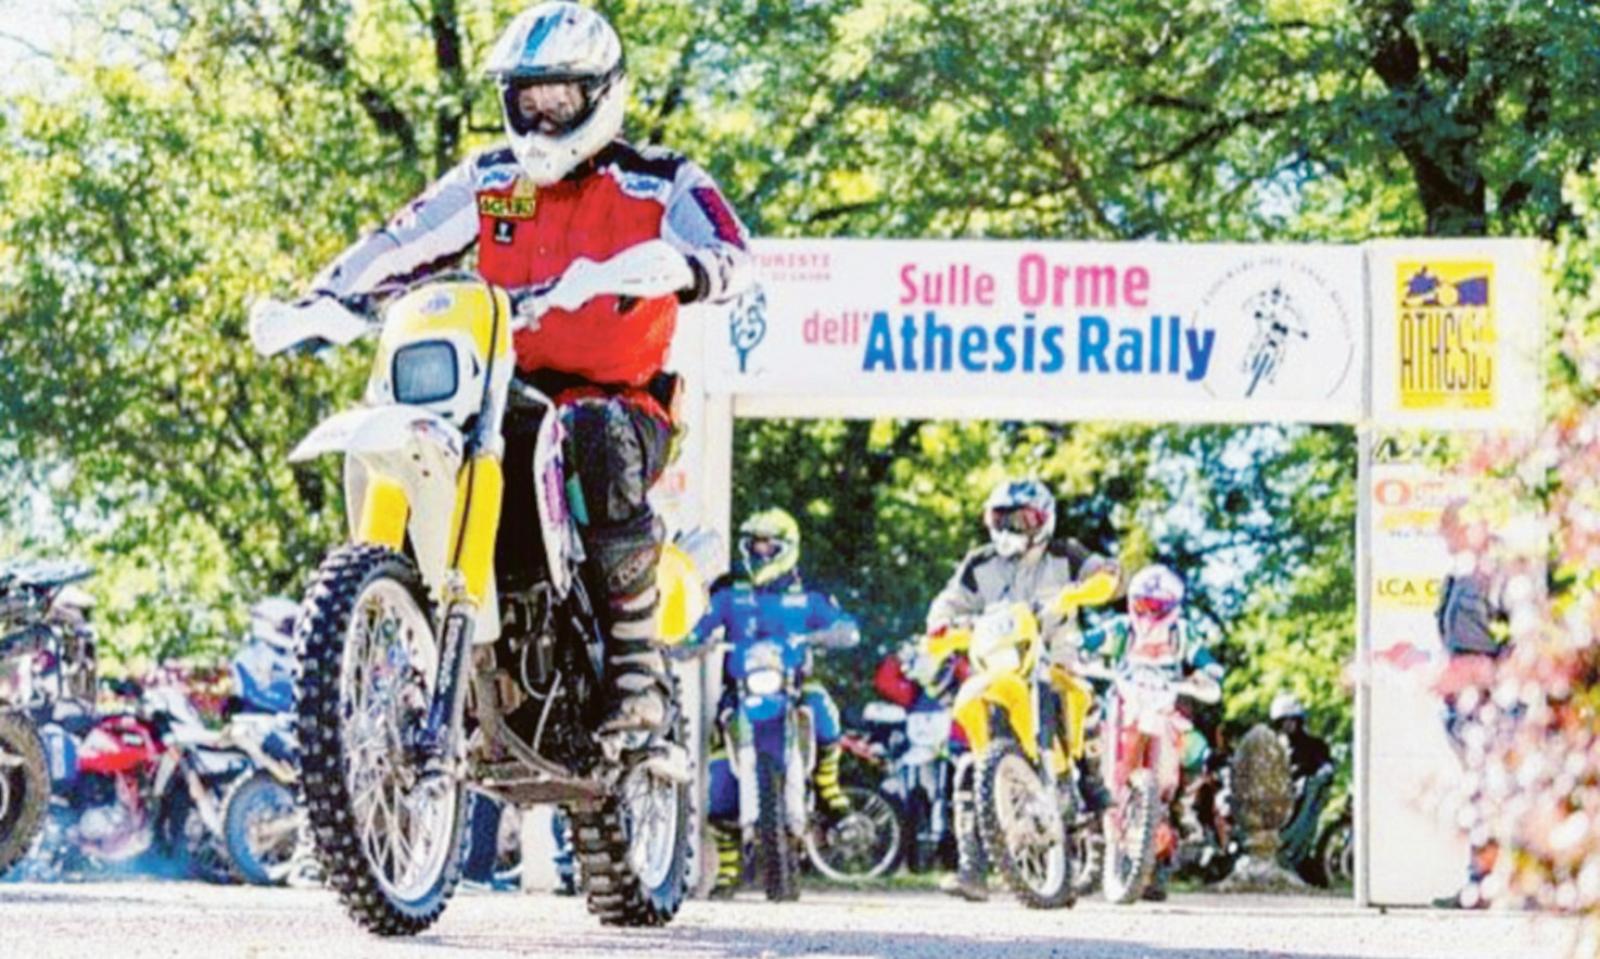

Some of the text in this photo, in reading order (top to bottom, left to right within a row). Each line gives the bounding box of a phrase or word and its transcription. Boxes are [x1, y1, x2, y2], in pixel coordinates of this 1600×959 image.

[899, 264, 995, 306] Sulle
[1018, 252, 1150, 307] Orme
[1078, 315, 1216, 382] Rally
